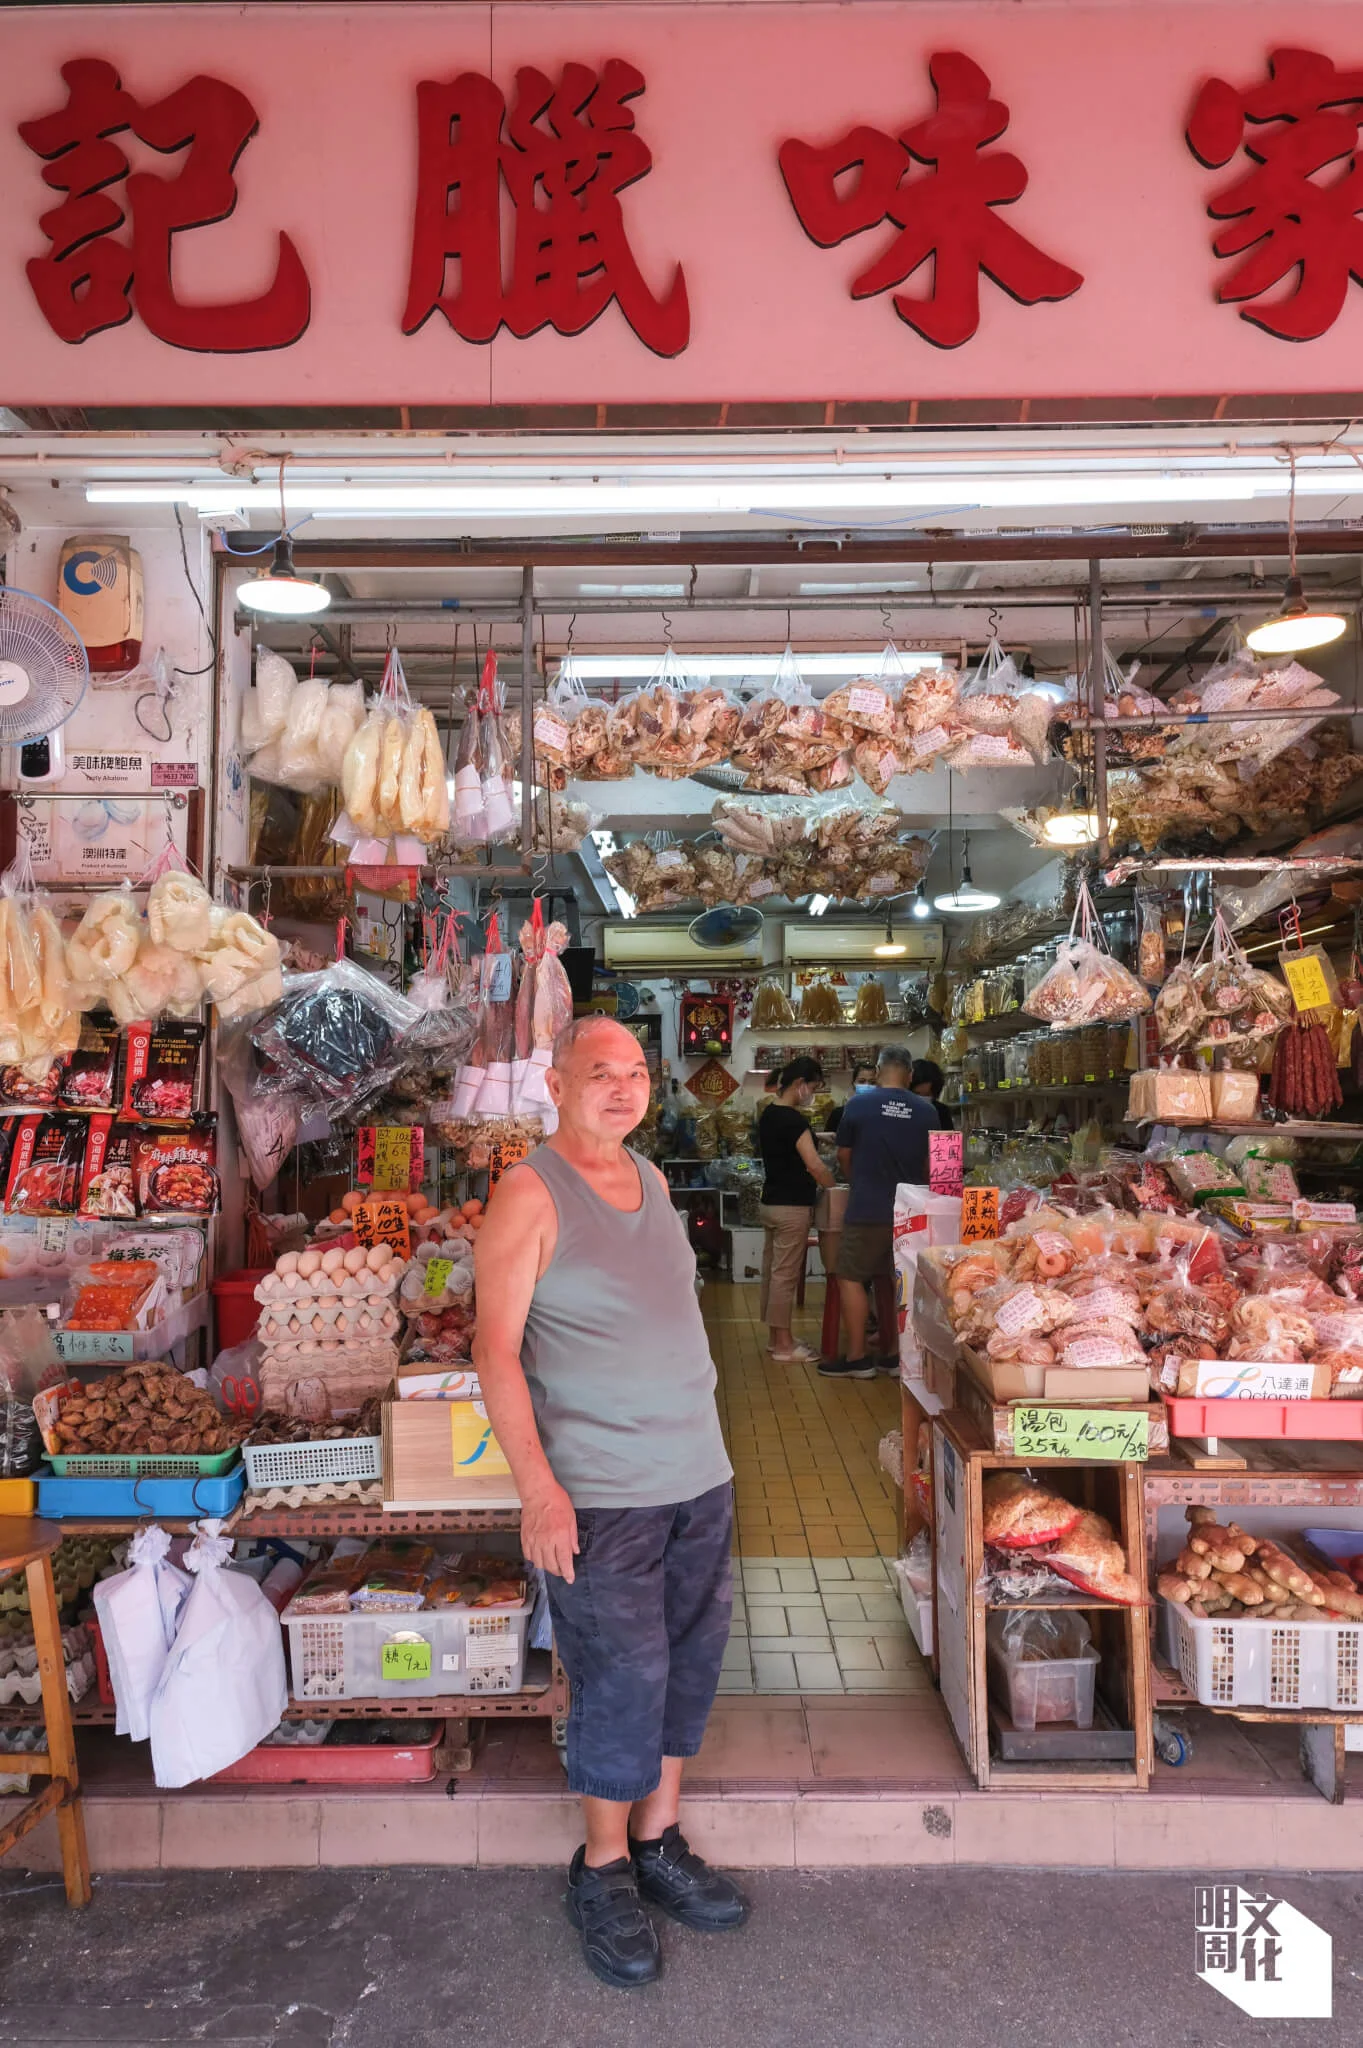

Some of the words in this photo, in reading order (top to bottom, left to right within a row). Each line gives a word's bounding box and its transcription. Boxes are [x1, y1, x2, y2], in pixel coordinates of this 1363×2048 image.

[72, 756, 142, 770] 美味牌鮑魚
[82, 848, 127, 860] 澳洲特產
[1261, 1375, 1309, 1391] 八達通
[1020, 1410, 1068, 1433] 湯包
